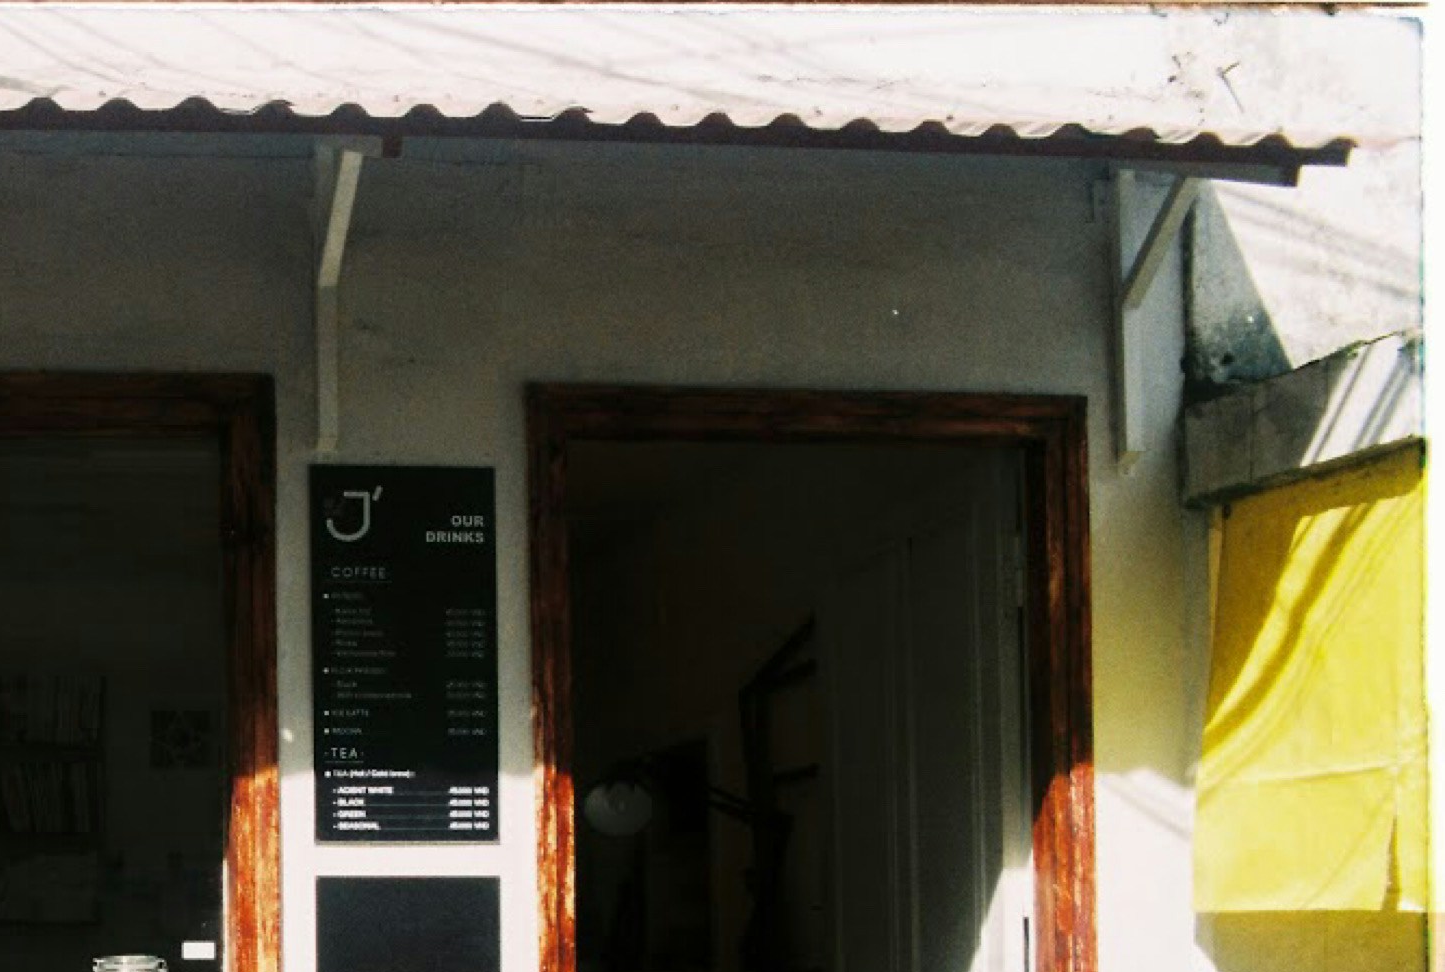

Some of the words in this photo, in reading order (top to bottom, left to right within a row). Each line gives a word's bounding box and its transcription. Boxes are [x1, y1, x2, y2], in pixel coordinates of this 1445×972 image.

[450, 515, 484, 527] OUR
[426, 530, 484, 543] DRINKS
[330, 566, 386, 579] COFFEE
[331, 747, 358, 759] TEA
